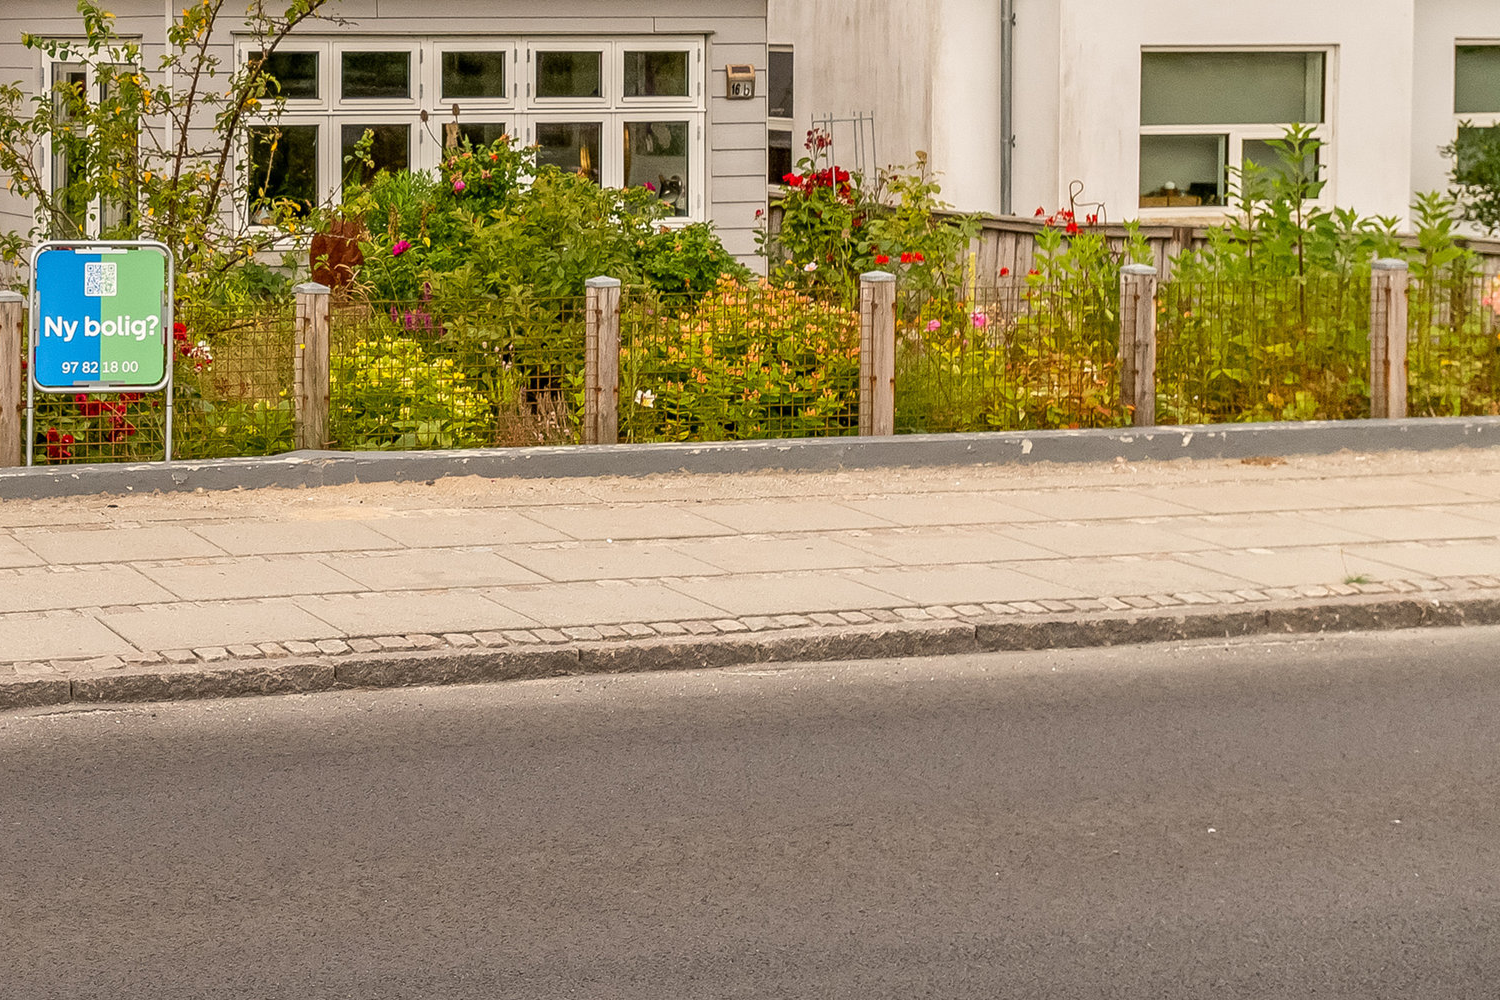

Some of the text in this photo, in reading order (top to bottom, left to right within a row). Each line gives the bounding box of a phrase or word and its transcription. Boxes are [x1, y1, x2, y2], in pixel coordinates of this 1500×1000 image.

[731, 83, 750, 97] 16 b
[44, 315, 159, 342] Ny bolig?
[61, 360, 139, 374] 97 82 18 00
